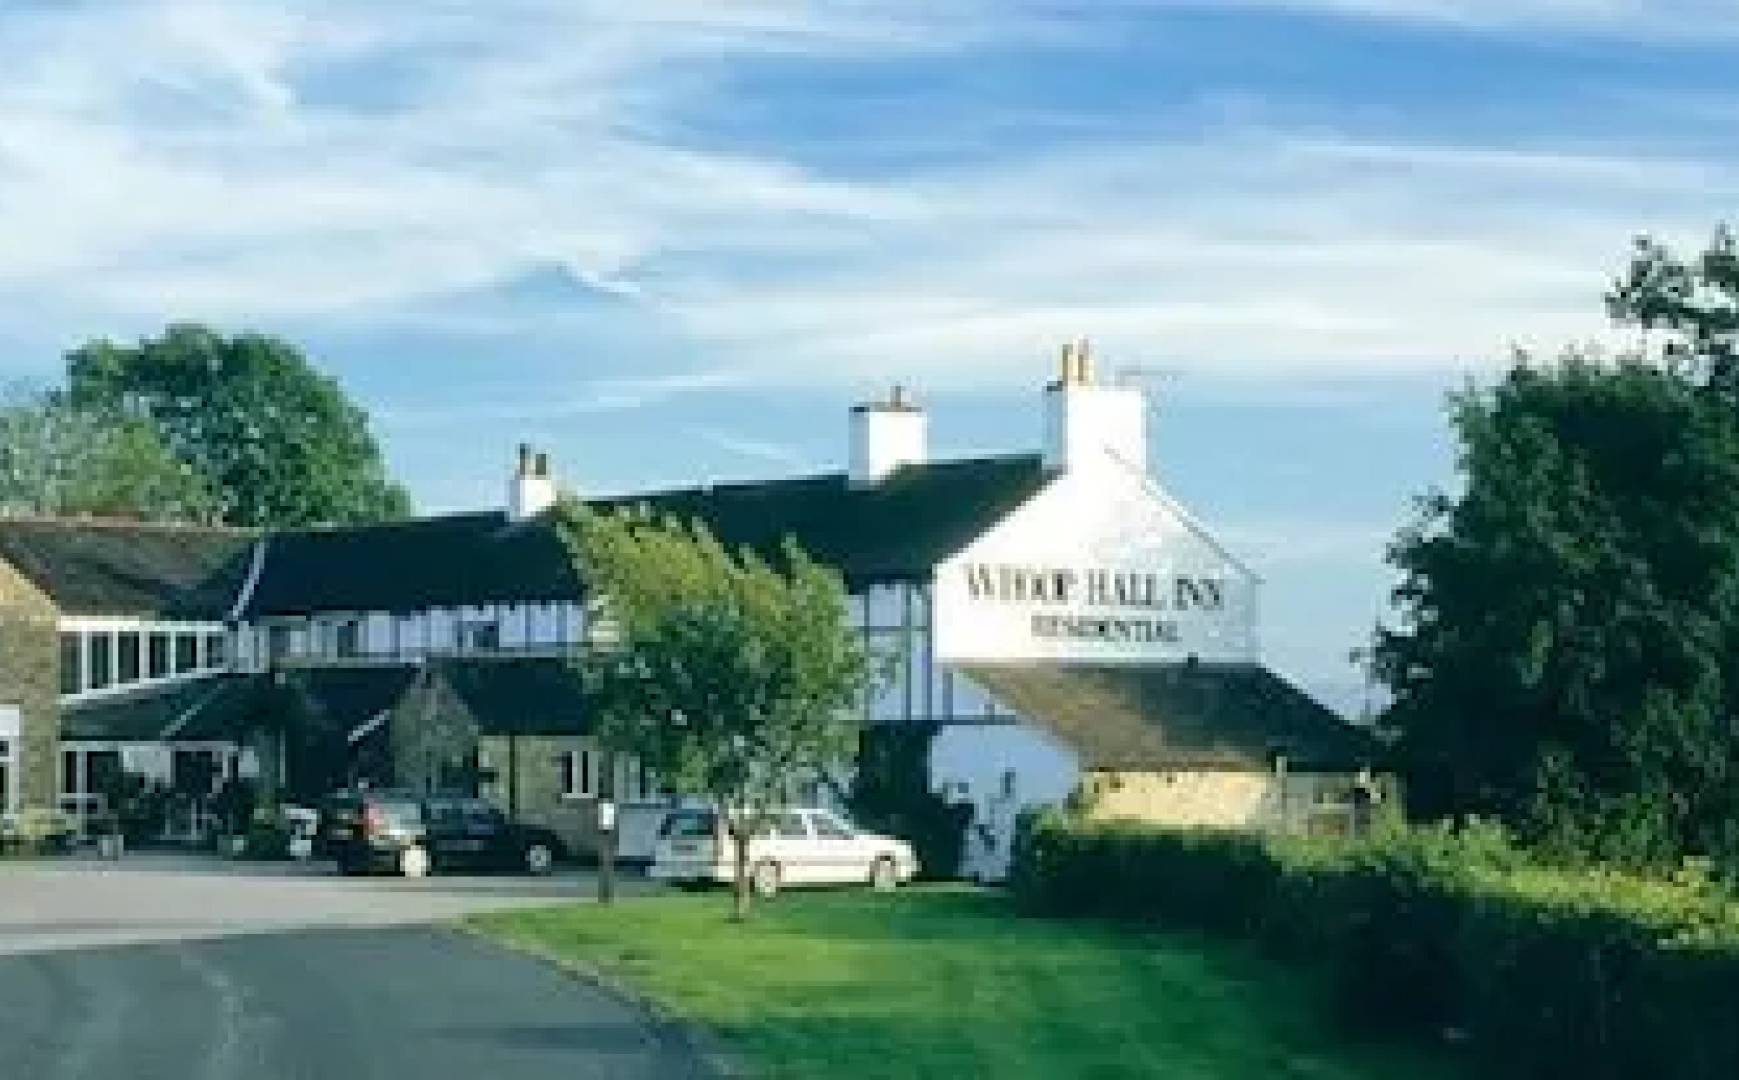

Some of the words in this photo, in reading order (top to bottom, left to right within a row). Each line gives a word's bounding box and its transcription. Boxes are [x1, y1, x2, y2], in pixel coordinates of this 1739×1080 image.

[965, 564, 1078, 604] WHOOP
[1085, 568, 1164, 607] HALL
[1173, 576, 1225, 611] INN
[1030, 613, 1182, 642] RESIDENTIAL
